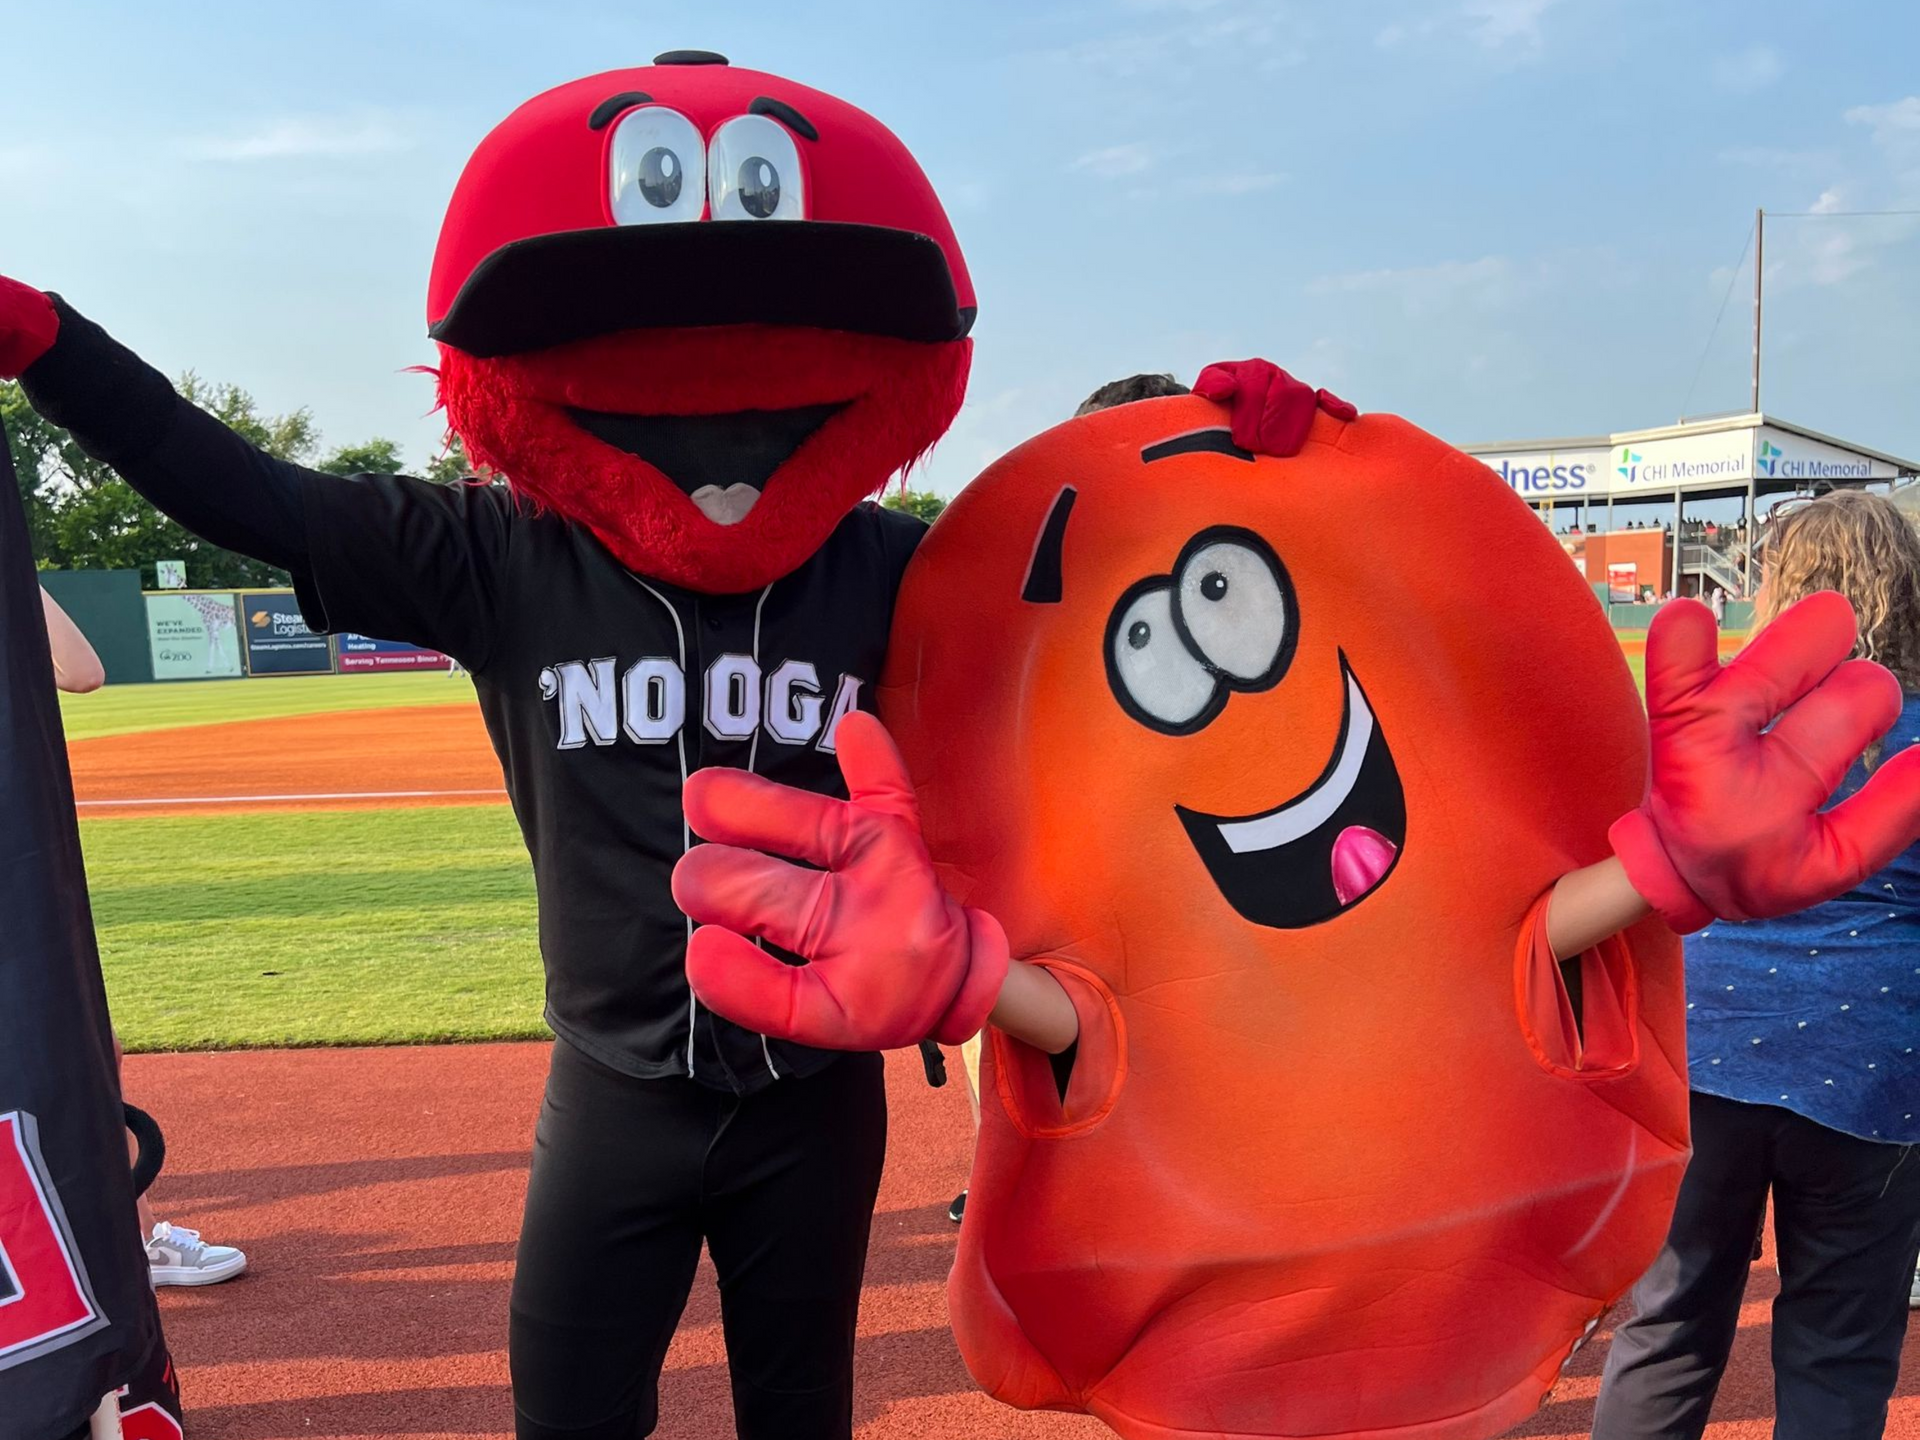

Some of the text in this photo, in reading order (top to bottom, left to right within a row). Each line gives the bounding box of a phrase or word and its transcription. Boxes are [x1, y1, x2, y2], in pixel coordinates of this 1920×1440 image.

[1642, 453, 1745, 481] CHI Memorial
[1781, 459, 1872, 477] CHI Memorial
[157, 627, 202, 635] EXPANDED
[347, 642, 376, 650] Heating
[345, 657, 374, 666] Serving
[375, 656, 415, 665] Tennessee
[417, 655, 438, 663] Since
